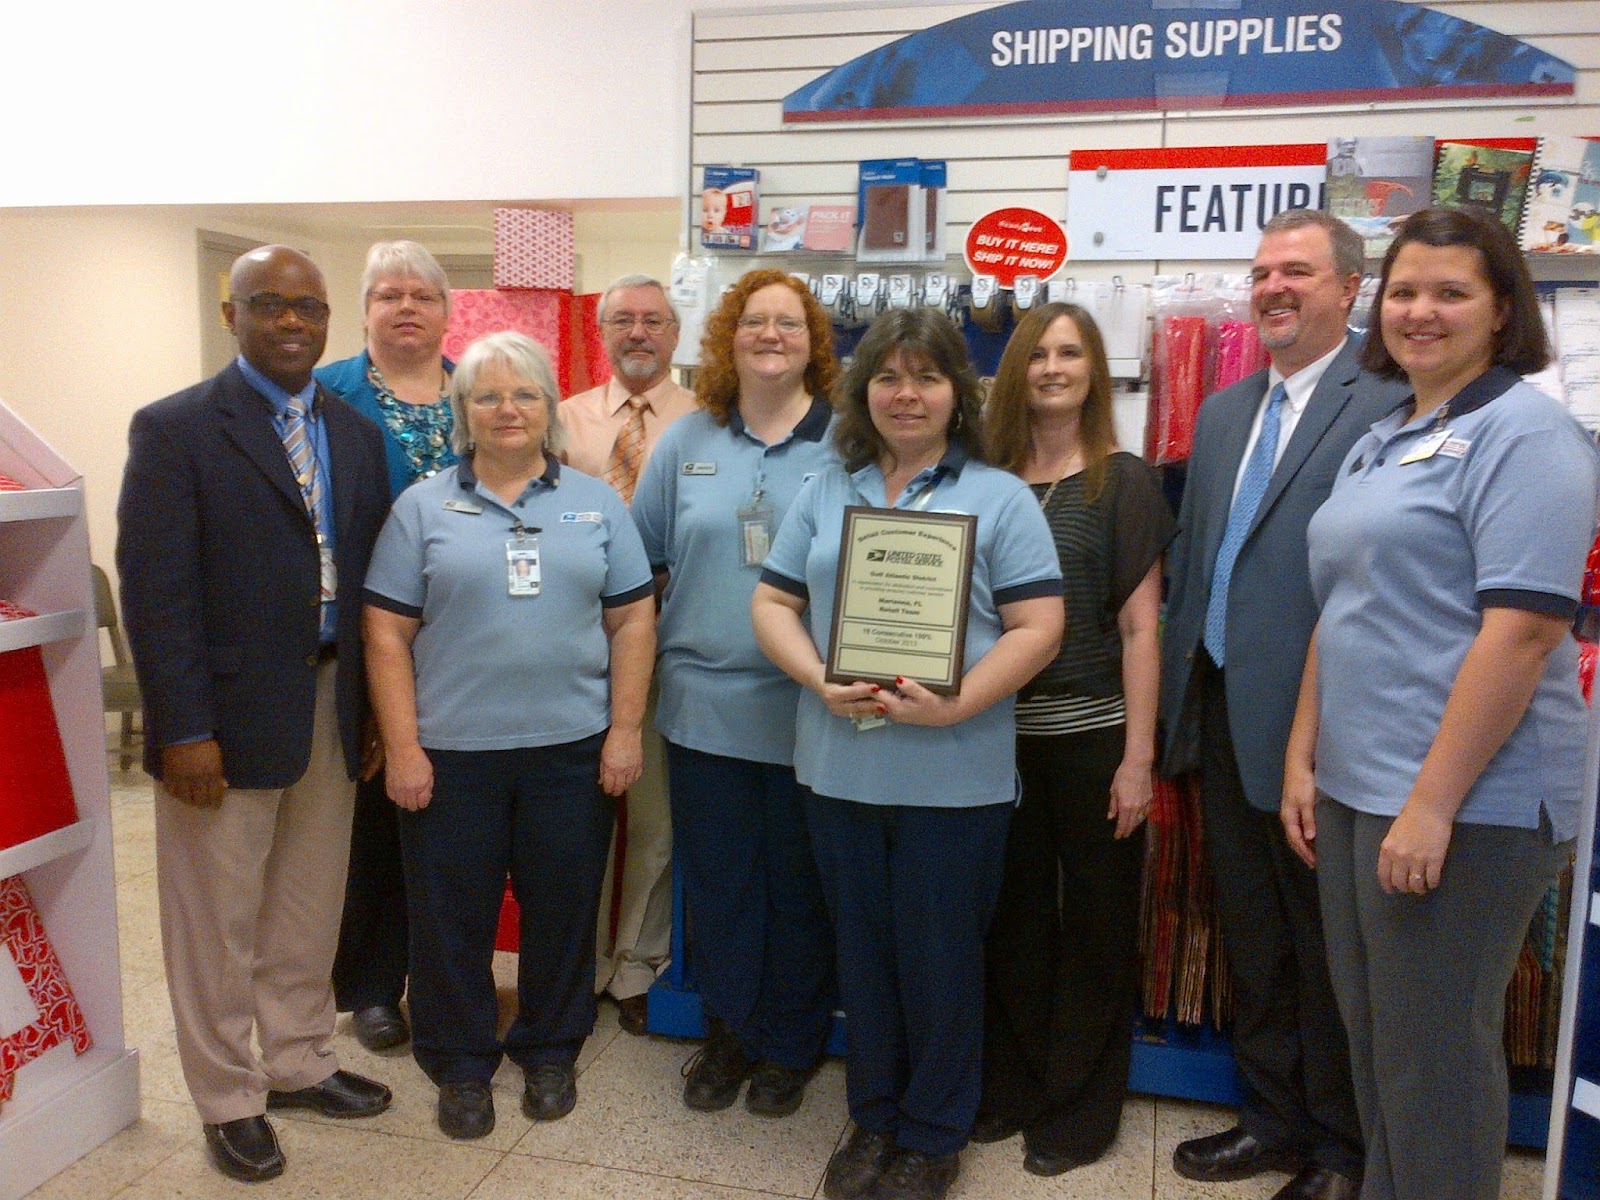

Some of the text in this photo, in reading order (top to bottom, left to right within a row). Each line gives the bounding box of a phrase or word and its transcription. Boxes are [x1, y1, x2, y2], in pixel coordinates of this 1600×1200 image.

[991, 14, 1342, 66] SHIPPING SUPPLIES
[1154, 182, 1326, 232] FEATUR
[976, 234, 1059, 255] BUY IT HERE!
[973, 250, 1055, 270] SHIP IT NOW!
[918, 531, 957, 551] Experience
[871, 629, 913, 638] Consecutive
